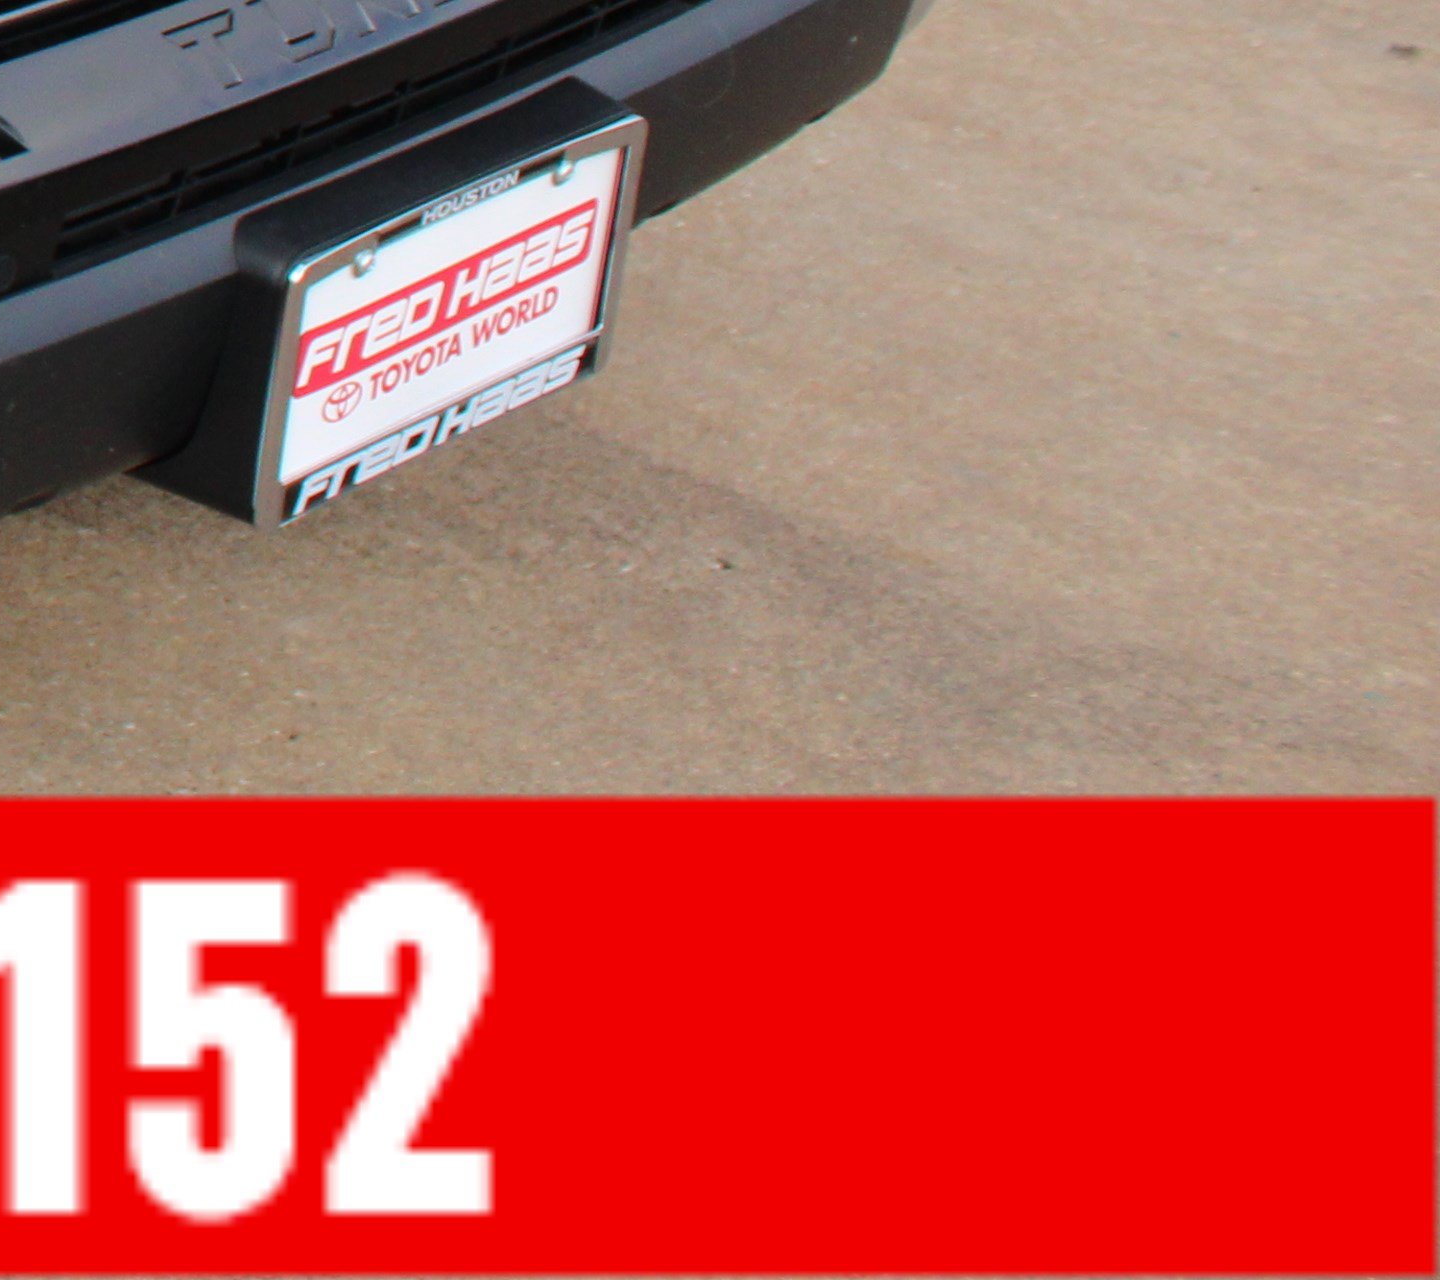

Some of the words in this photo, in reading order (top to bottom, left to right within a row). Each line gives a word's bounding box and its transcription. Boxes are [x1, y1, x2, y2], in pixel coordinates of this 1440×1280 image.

[420, 169, 521, 226] HOUSTON
[370, 332, 461, 400] TOYOTA
[472, 286, 560, 349] WORLD
